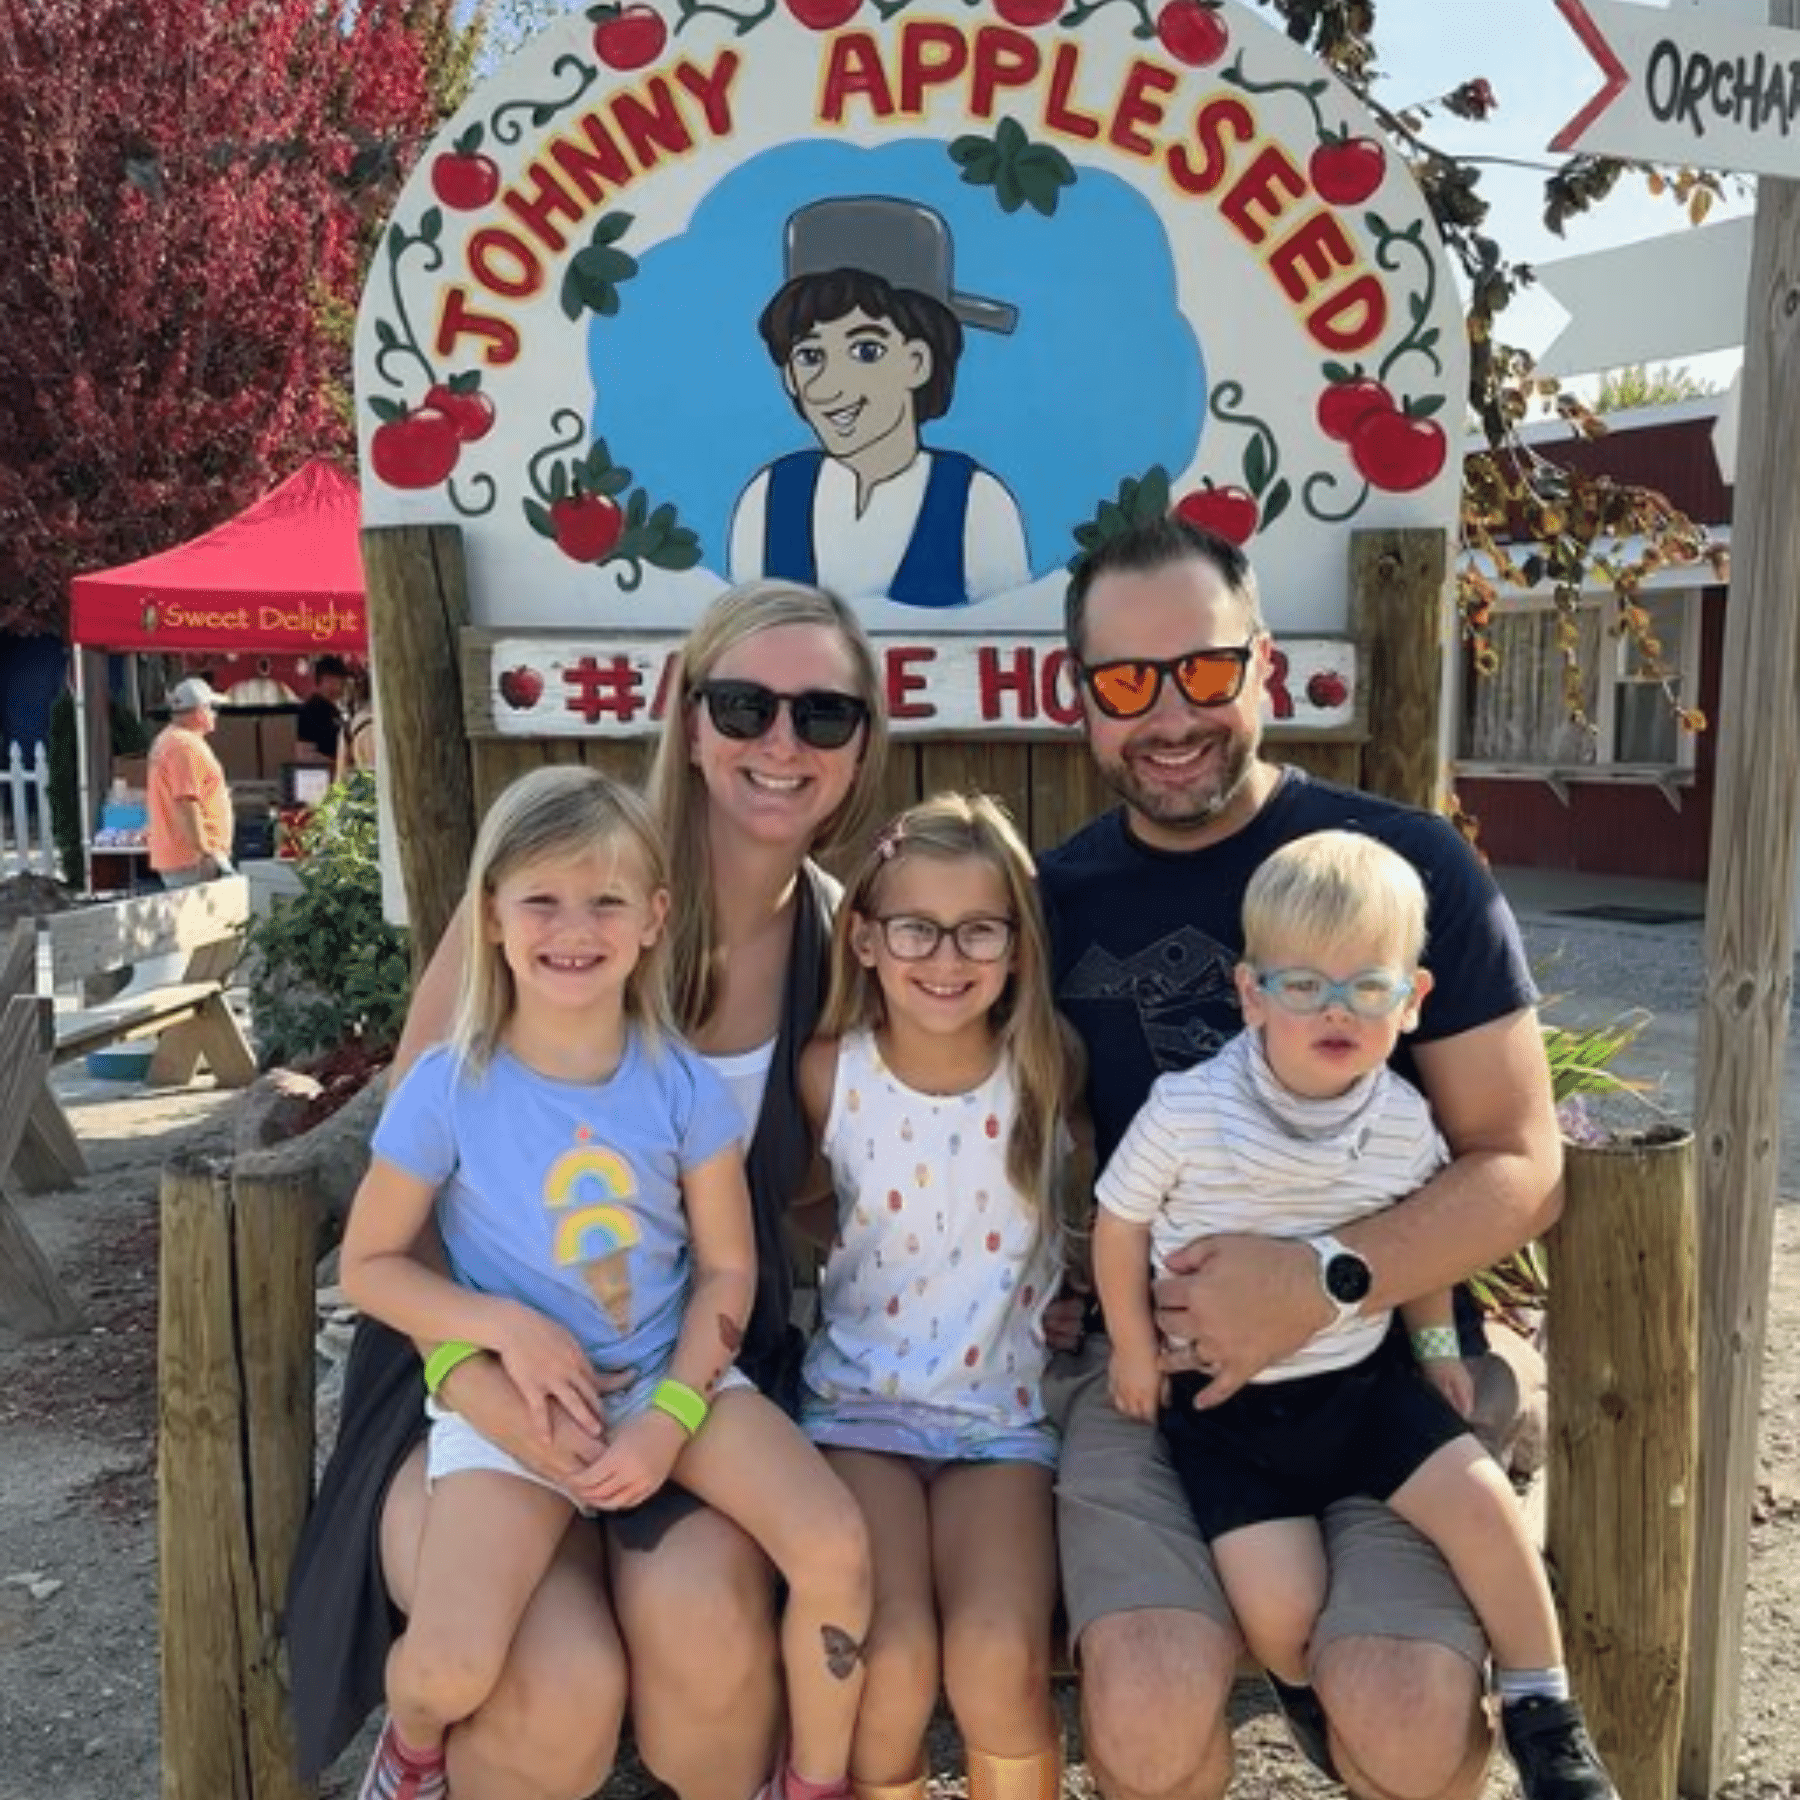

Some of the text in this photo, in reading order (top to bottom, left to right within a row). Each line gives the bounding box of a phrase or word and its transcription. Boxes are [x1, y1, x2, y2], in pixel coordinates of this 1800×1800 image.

[435, 20, 1388, 366] JOHNNY APPLESEED
[164, 600, 358, 641] Sweet Delight
